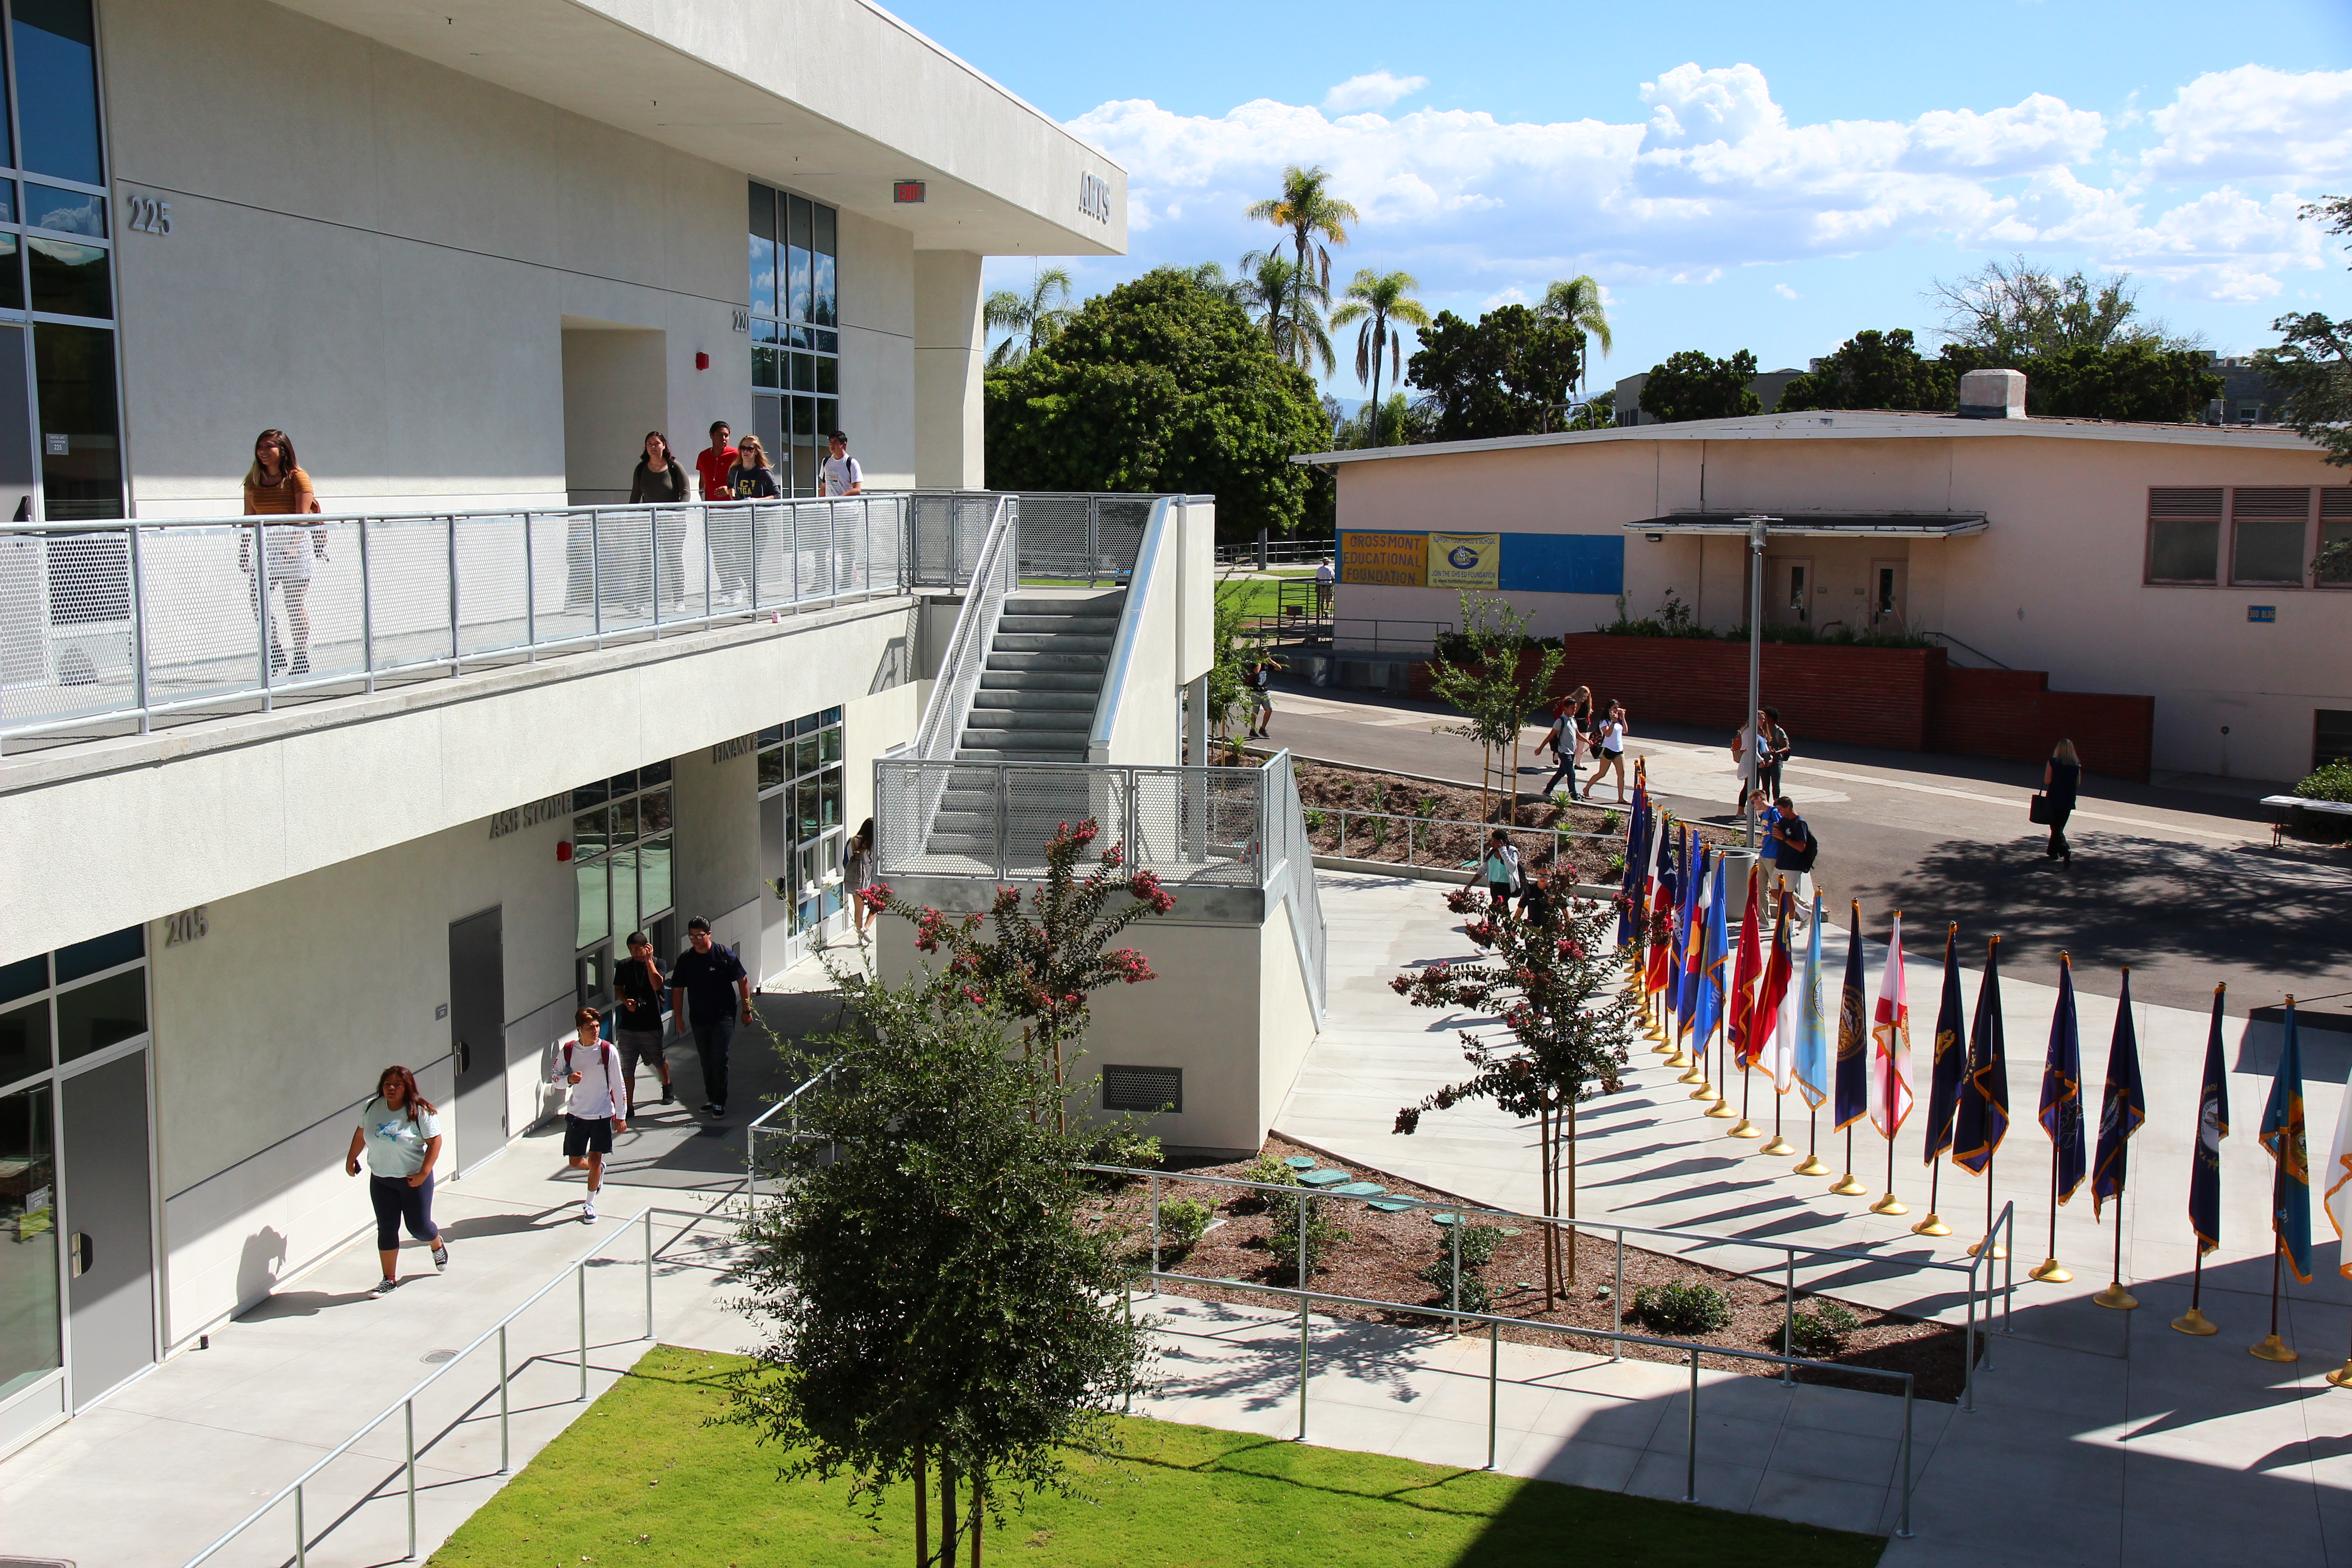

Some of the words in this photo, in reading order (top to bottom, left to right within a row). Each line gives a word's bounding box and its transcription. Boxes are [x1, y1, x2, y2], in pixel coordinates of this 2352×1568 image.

[899, 186, 919, 200] EXIT
[1079, 170, 1111, 224] ARTS
[127, 196, 173, 236] 225
[733, 311, 750, 333] 220
[1350, 535, 1421, 551] GROSSMONT
[1343, 552, 1421, 568] EDUCATIONAL
[1347, 568, 1416, 584] FOUNDATION
[2249, 610, 2259, 618] 300
[2262, 610, 2275, 618] BLDG
[713, 732, 758, 764] FINANCE
[489, 808, 519, 839] ASB
[524, 794, 572, 828] STORE
[165, 906, 209, 947] 205
[30, 1193, 45, 1203] CLASSROOM
[34, 1199, 42, 1207] 205
